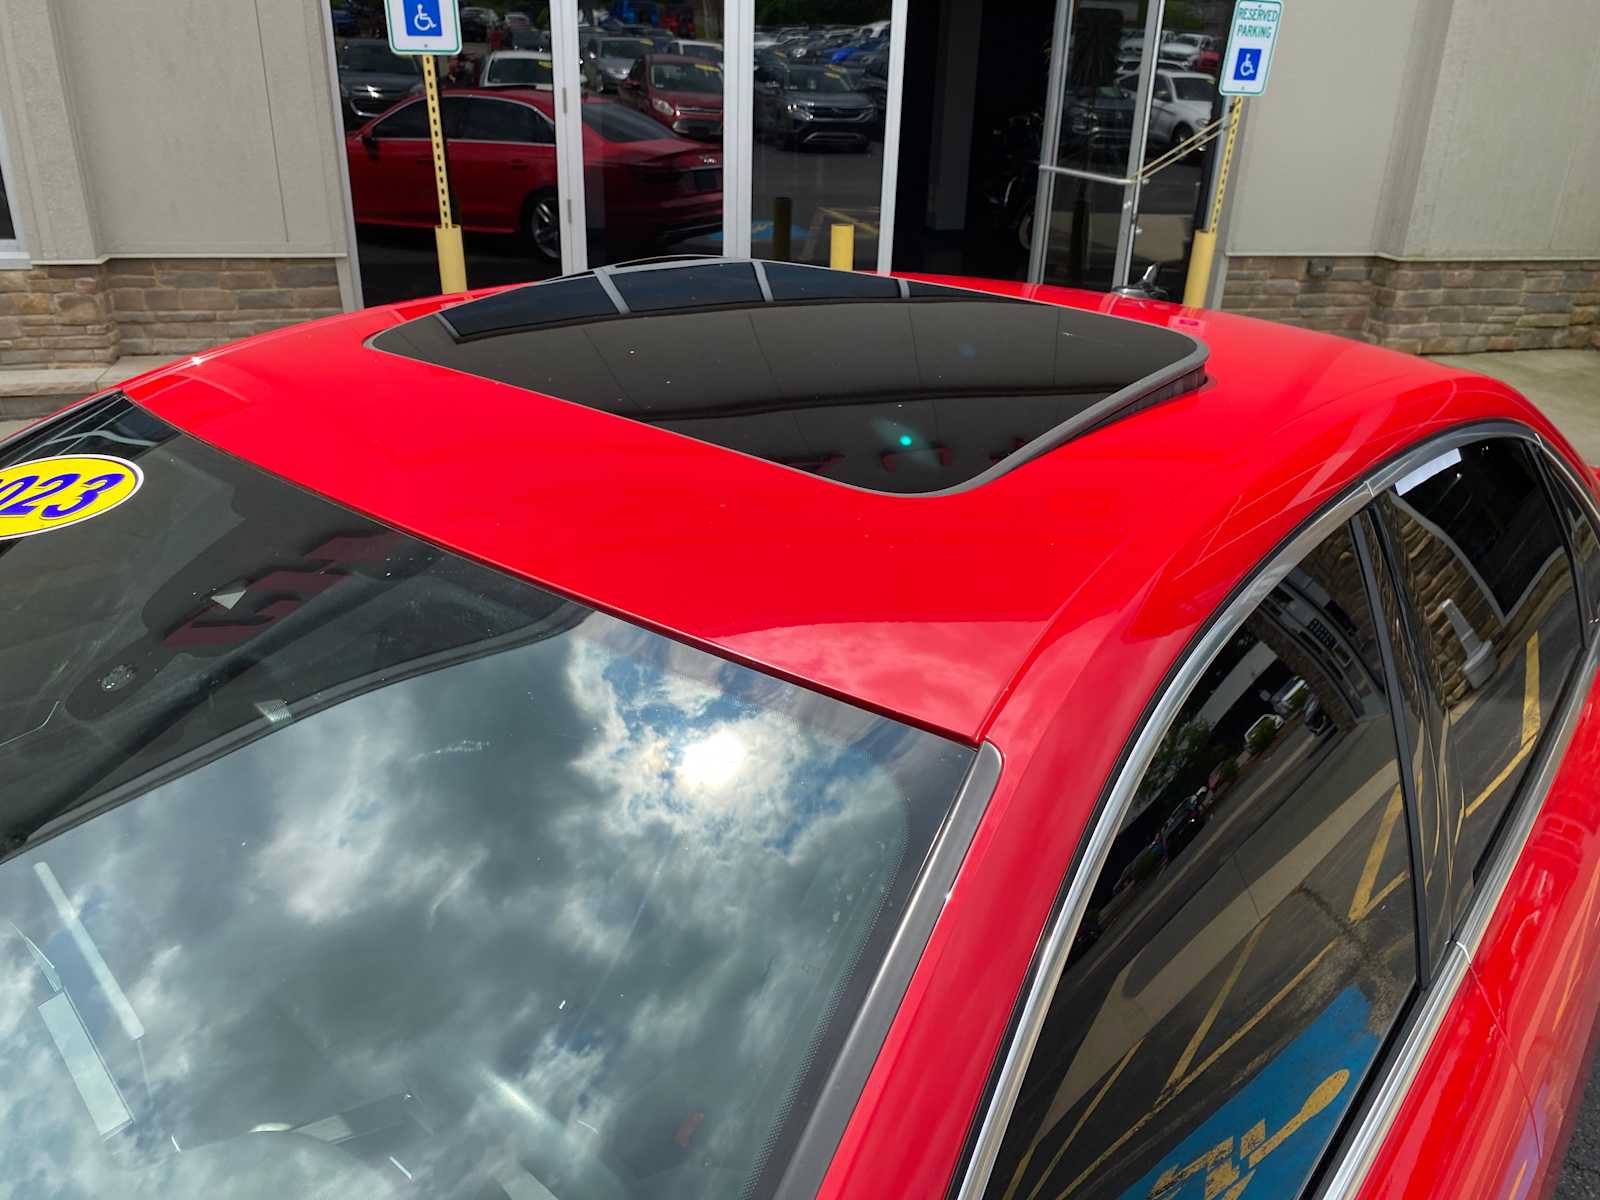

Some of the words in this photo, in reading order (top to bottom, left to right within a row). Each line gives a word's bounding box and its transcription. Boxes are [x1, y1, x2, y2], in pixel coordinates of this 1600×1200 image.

[1238, 8, 1279, 22] RESERVED
[1237, 24, 1272, 39] PARKING
[0, 473, 125, 518] 023
